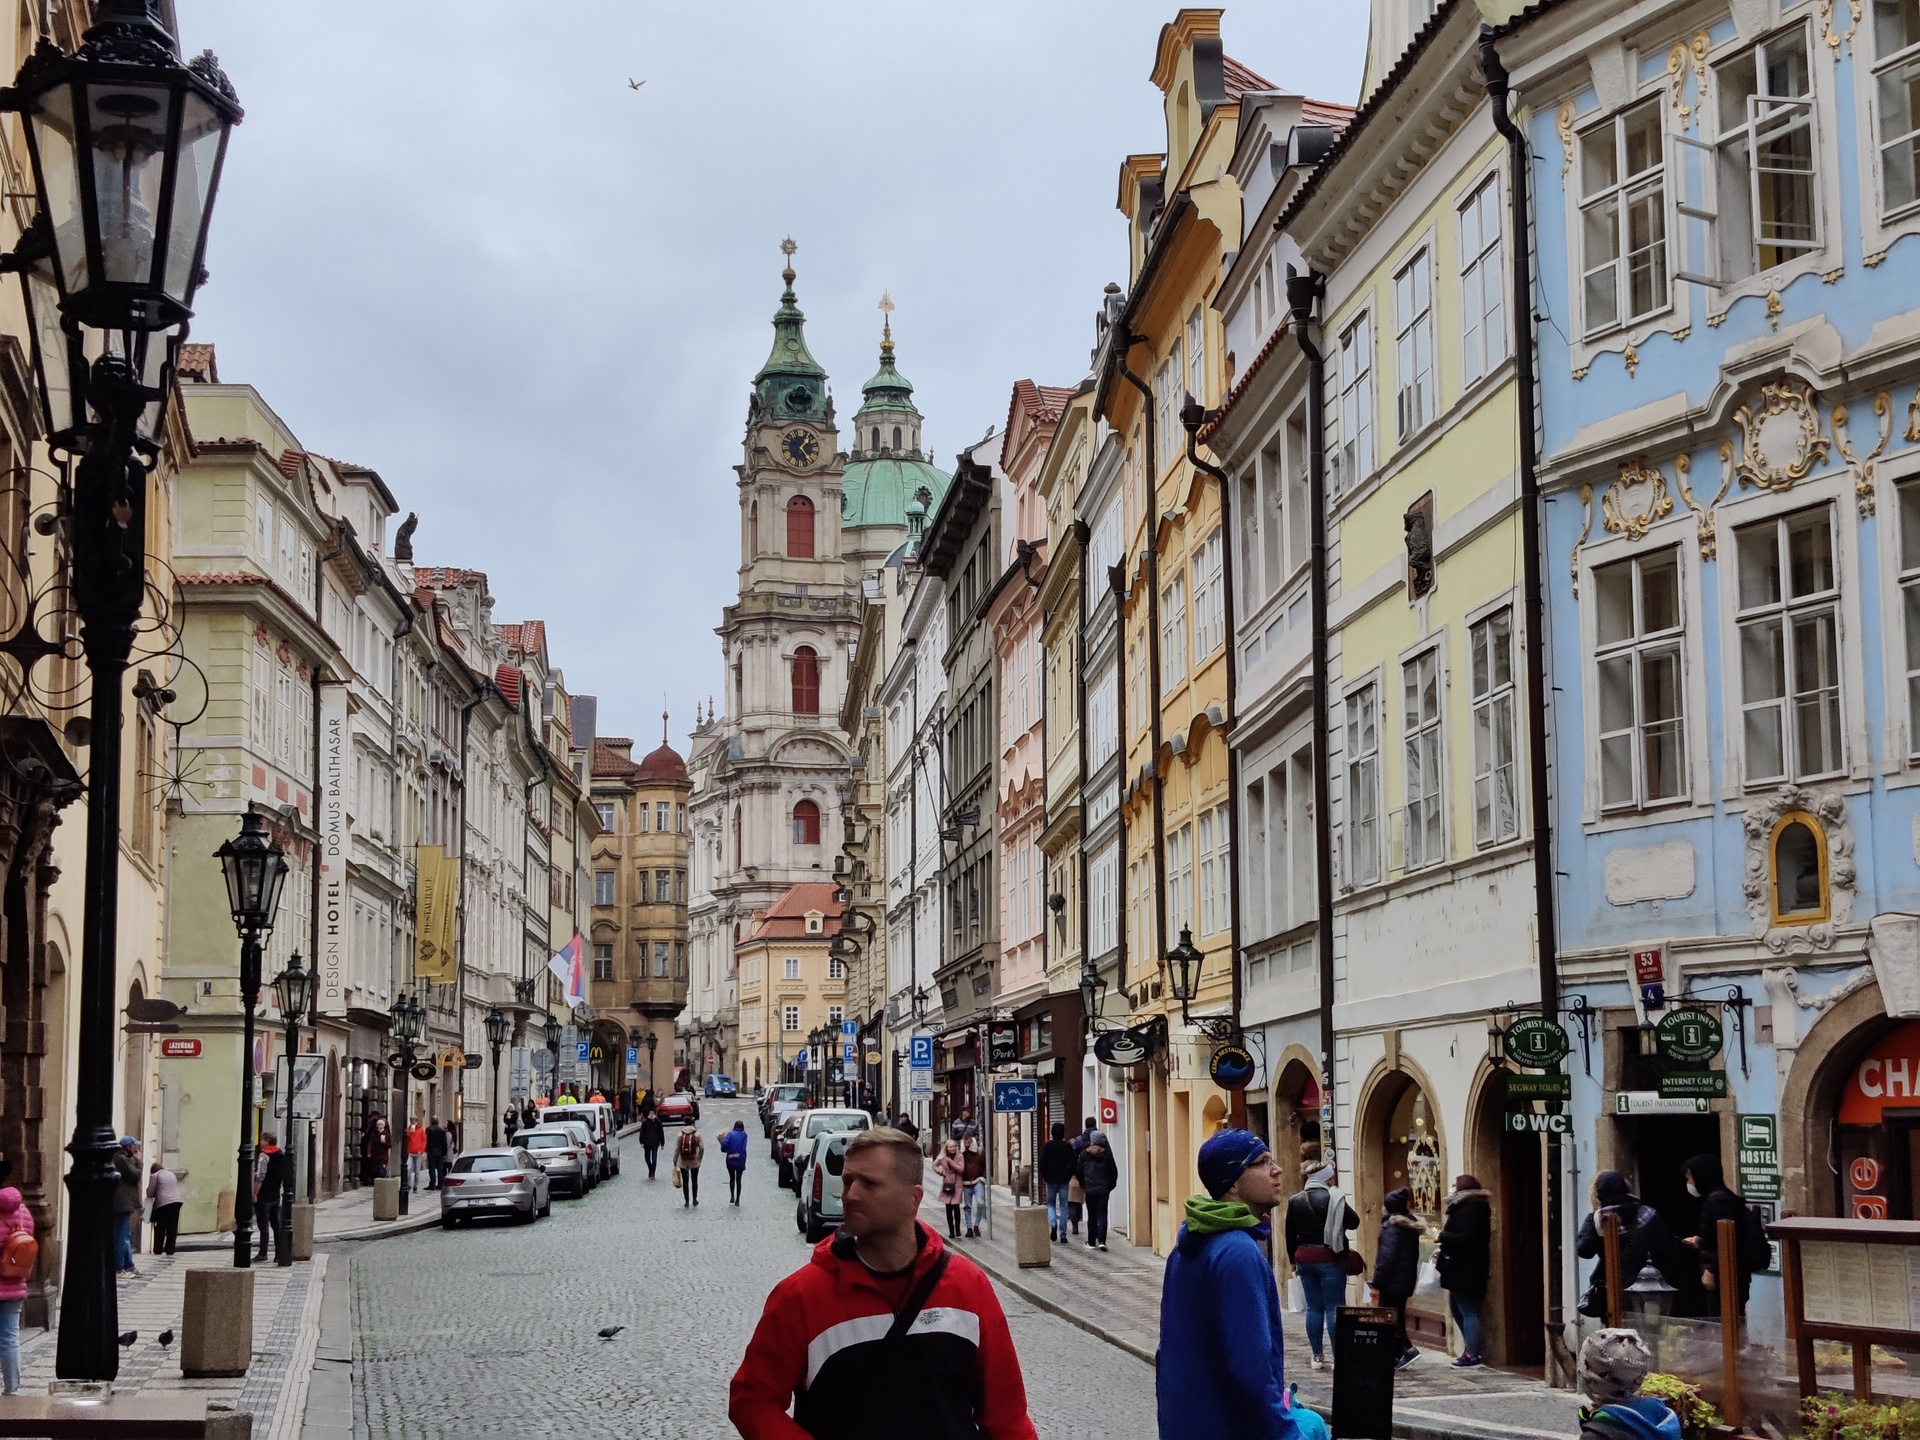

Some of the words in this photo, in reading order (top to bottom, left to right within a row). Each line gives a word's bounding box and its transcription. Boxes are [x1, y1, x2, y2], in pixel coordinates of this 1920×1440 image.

[328, 718, 341, 796] BALTHASAR
[328, 802, 341, 856] DOMUS
[327, 880, 340, 935] HOTEL
[424, 876, 433, 934] RESTAURACE
[1640, 952, 1653, 967] 53
[326, 941, 339, 998] DESIGN
[1663, 1011, 1695, 1029] TOURIST
[1697, 1013, 1716, 1029] INFO
[1511, 1020, 1542, 1036] TOURIST
[1544, 1021, 1562, 1036] INFO
[168, 1041, 195, 1049] LÁZEŇSKÁ
[577, 1044, 587, 1056] P
[845, 1045, 853, 1057] P
[914, 1040, 928, 1059] P
[628, 1050, 636, 1060] P
[1218, 1047, 1251, 1062] RESTAURACE
[1516, 1048, 1538, 1060] CLASSICAL
[1538, 1049, 1559, 1060] CONCERTS
[1667, 1049, 1685, 1061] TOURS
[1508, 1083, 1537, 1092] SEGWAY
[1539, 1083, 1561, 1092] TOURS
[1662, 1077, 1696, 1086] INTERNET
[1696, 1075, 1713, 1085] CAFÉ
[1630, 1099, 1653, 1108] TOURIST
[1654, 1099, 1694, 1108] INFORMATION
[1529, 1114, 1566, 1132] WC
[1740, 1150, 1778, 1164] HOSTEL
